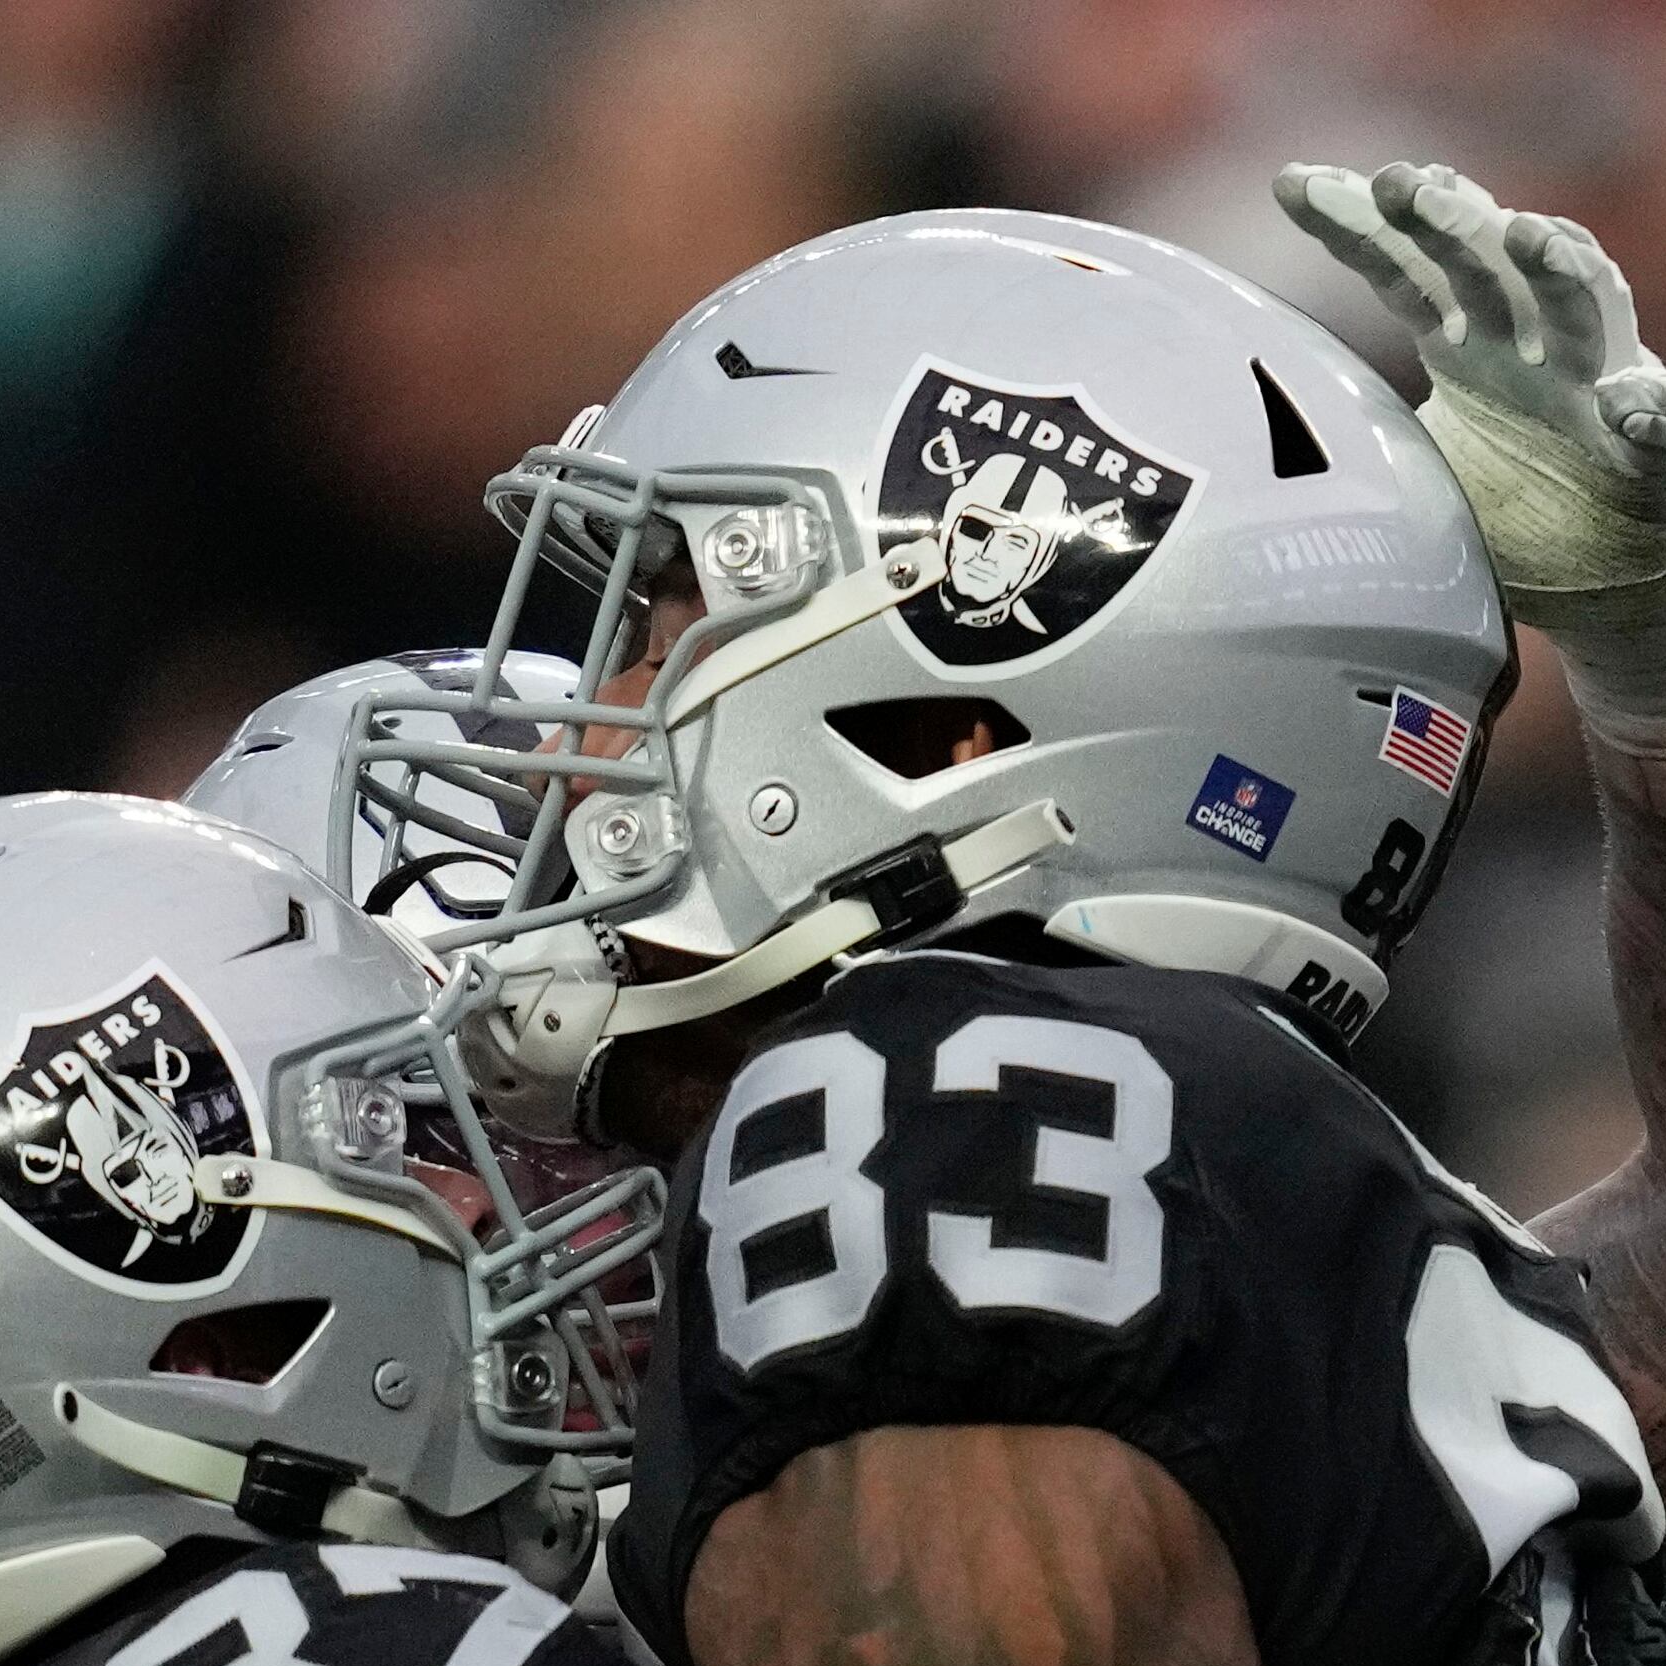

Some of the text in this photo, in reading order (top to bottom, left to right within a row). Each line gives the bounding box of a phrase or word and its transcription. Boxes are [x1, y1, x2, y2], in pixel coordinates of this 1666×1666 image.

[938, 385, 1163, 498] RAIDERS
[1195, 805, 1267, 852] CHANGE
[1341, 817, 1426, 938] 8
[698, 1014, 1174, 1372] 83
